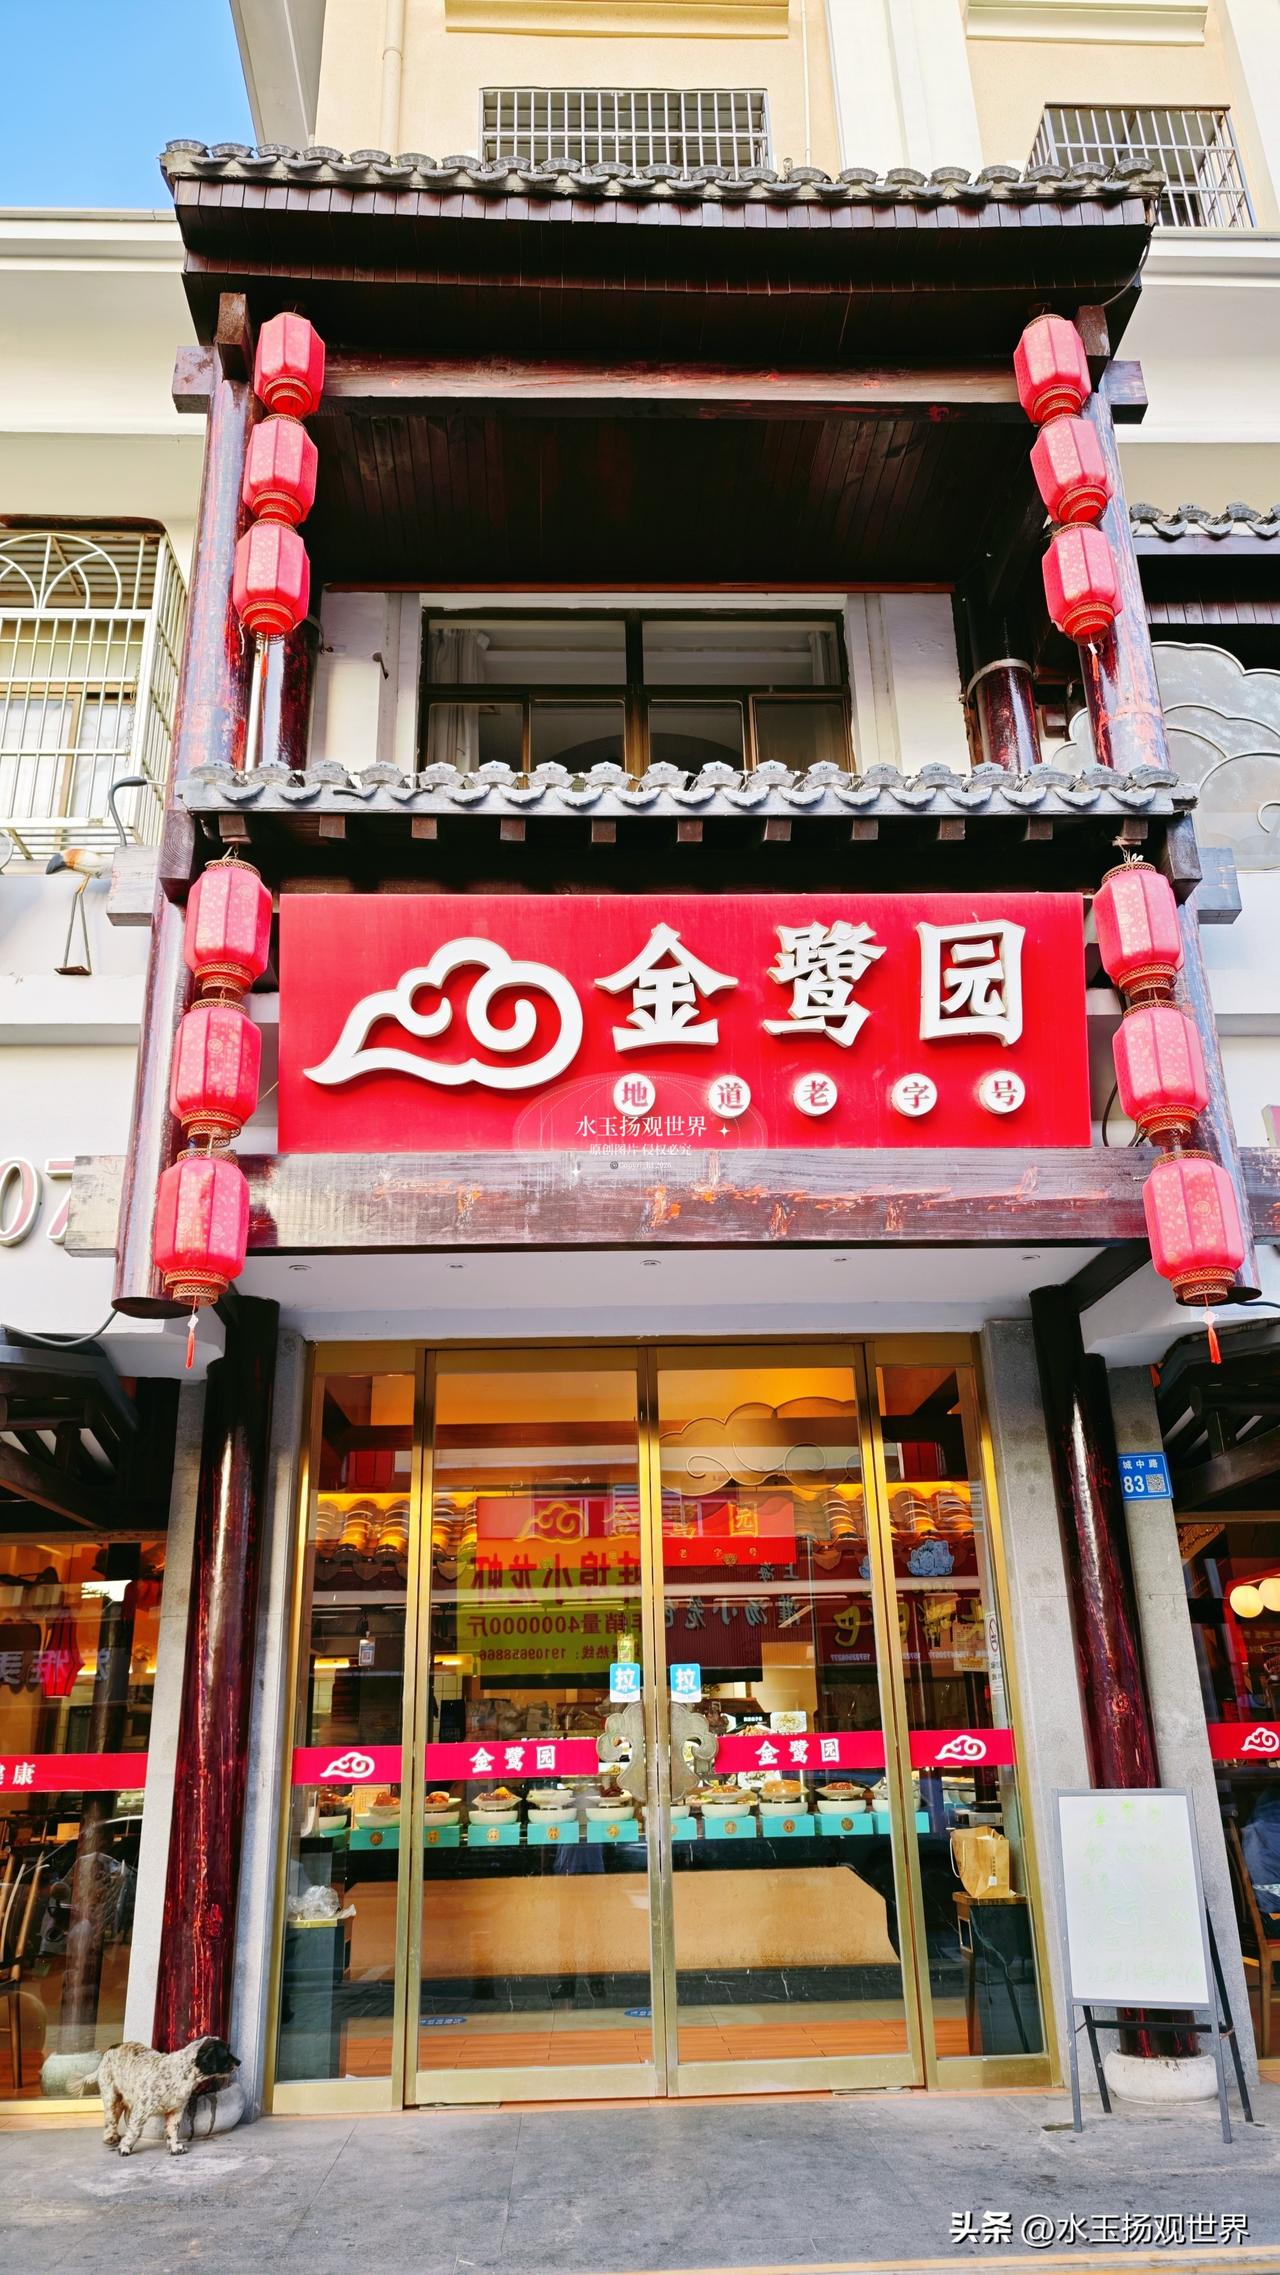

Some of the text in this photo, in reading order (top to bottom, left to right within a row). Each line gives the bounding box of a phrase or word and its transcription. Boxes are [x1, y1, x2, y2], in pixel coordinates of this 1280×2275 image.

[594, 920, 1027, 1051] 金鹭园
[621, 1080, 1019, 1110] 地道老字号
[1122, 1458, 1158, 1470] 城中路
[1123, 1475, 1145, 1493] 83
[615, 1667, 637, 1692] 拉
[675, 1668, 697, 1692] 拉
[469, 1745, 556, 1774] 金鹭园
[755, 1738, 840, 1766] 金鹭园
[0, 1761, 36, 1786] 康
